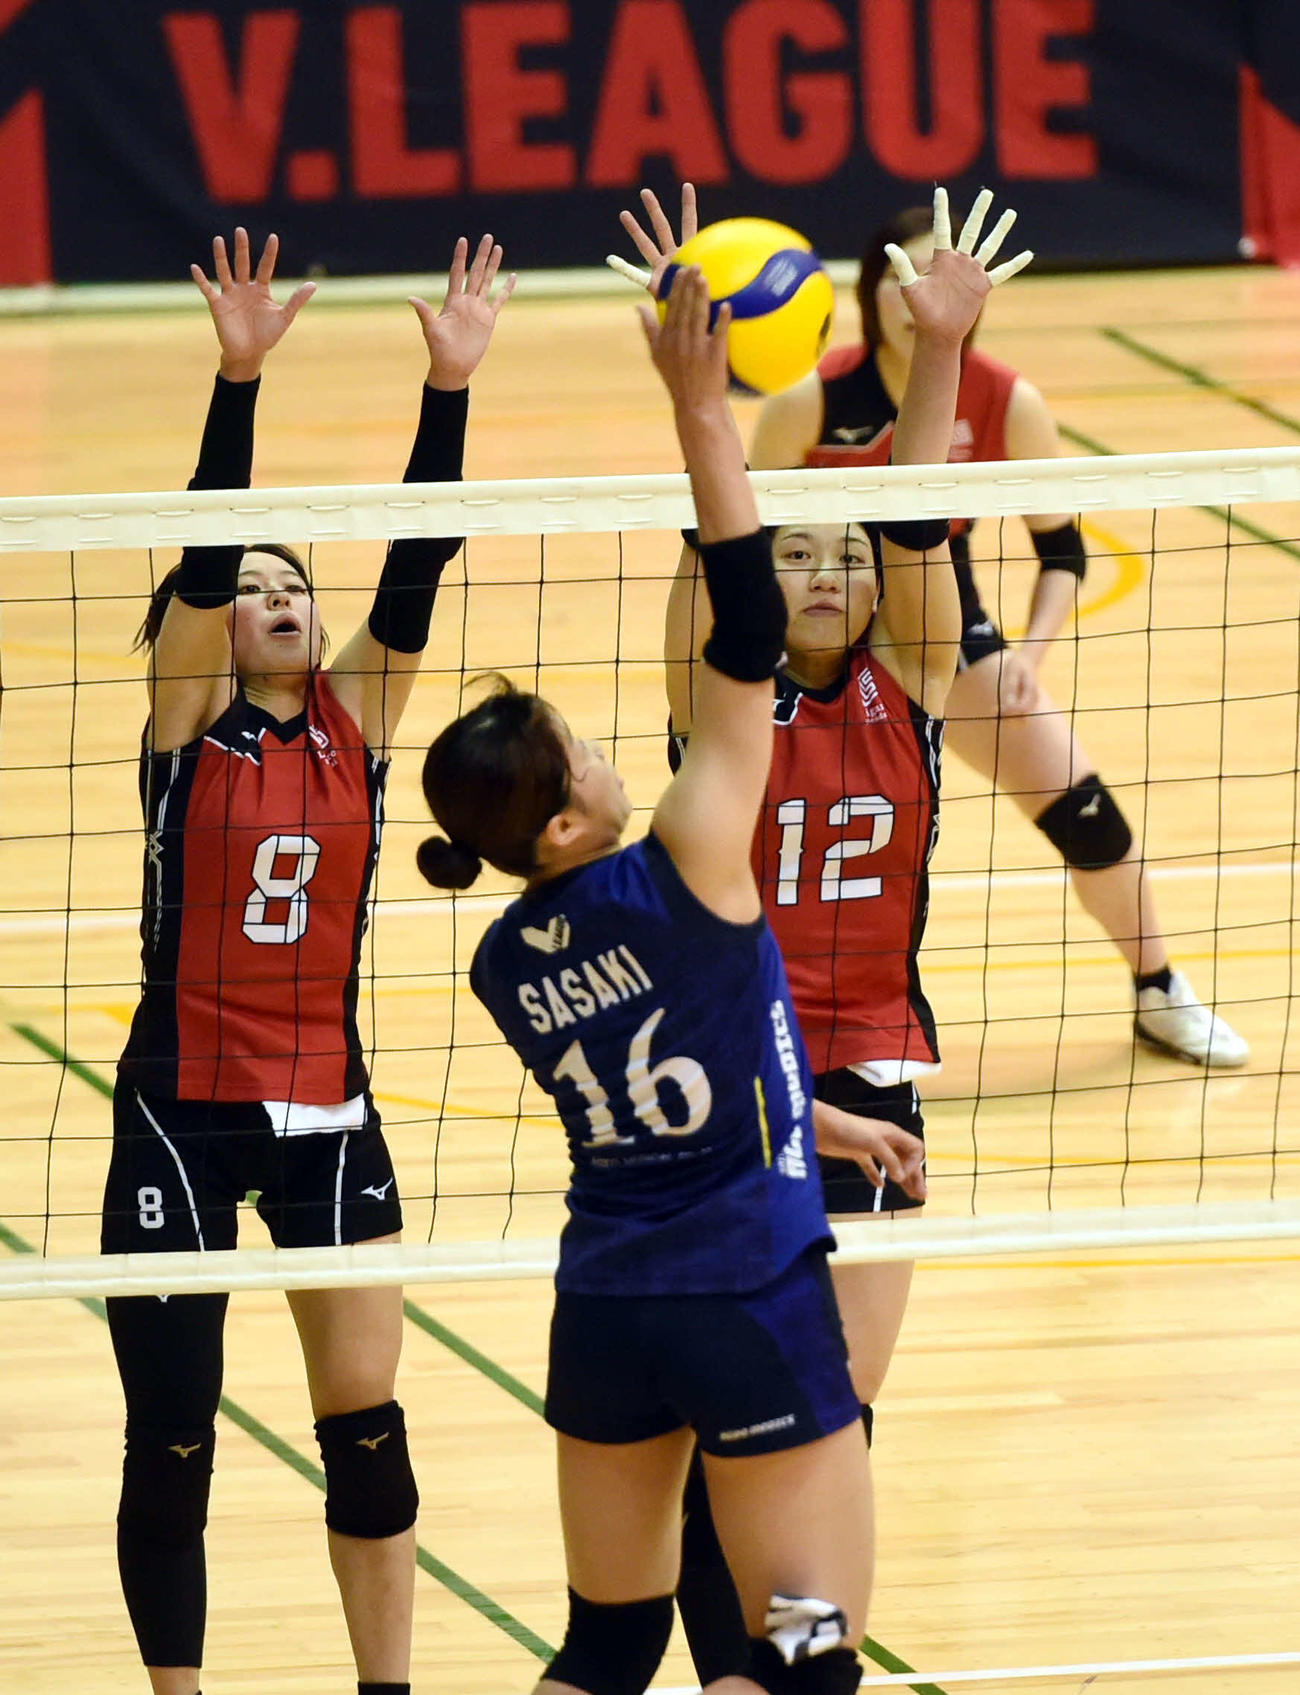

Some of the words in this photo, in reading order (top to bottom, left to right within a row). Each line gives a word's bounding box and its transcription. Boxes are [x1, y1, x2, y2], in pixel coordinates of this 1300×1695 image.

[162, 0, 1098, 204] V.LEAGUE
[242, 833, 322, 944] 8
[776, 795, 895, 907] 12
[518, 944, 653, 1035] SASAKI
[553, 1007, 712, 1148] 16
[137, 1186, 165, 1230] 8
